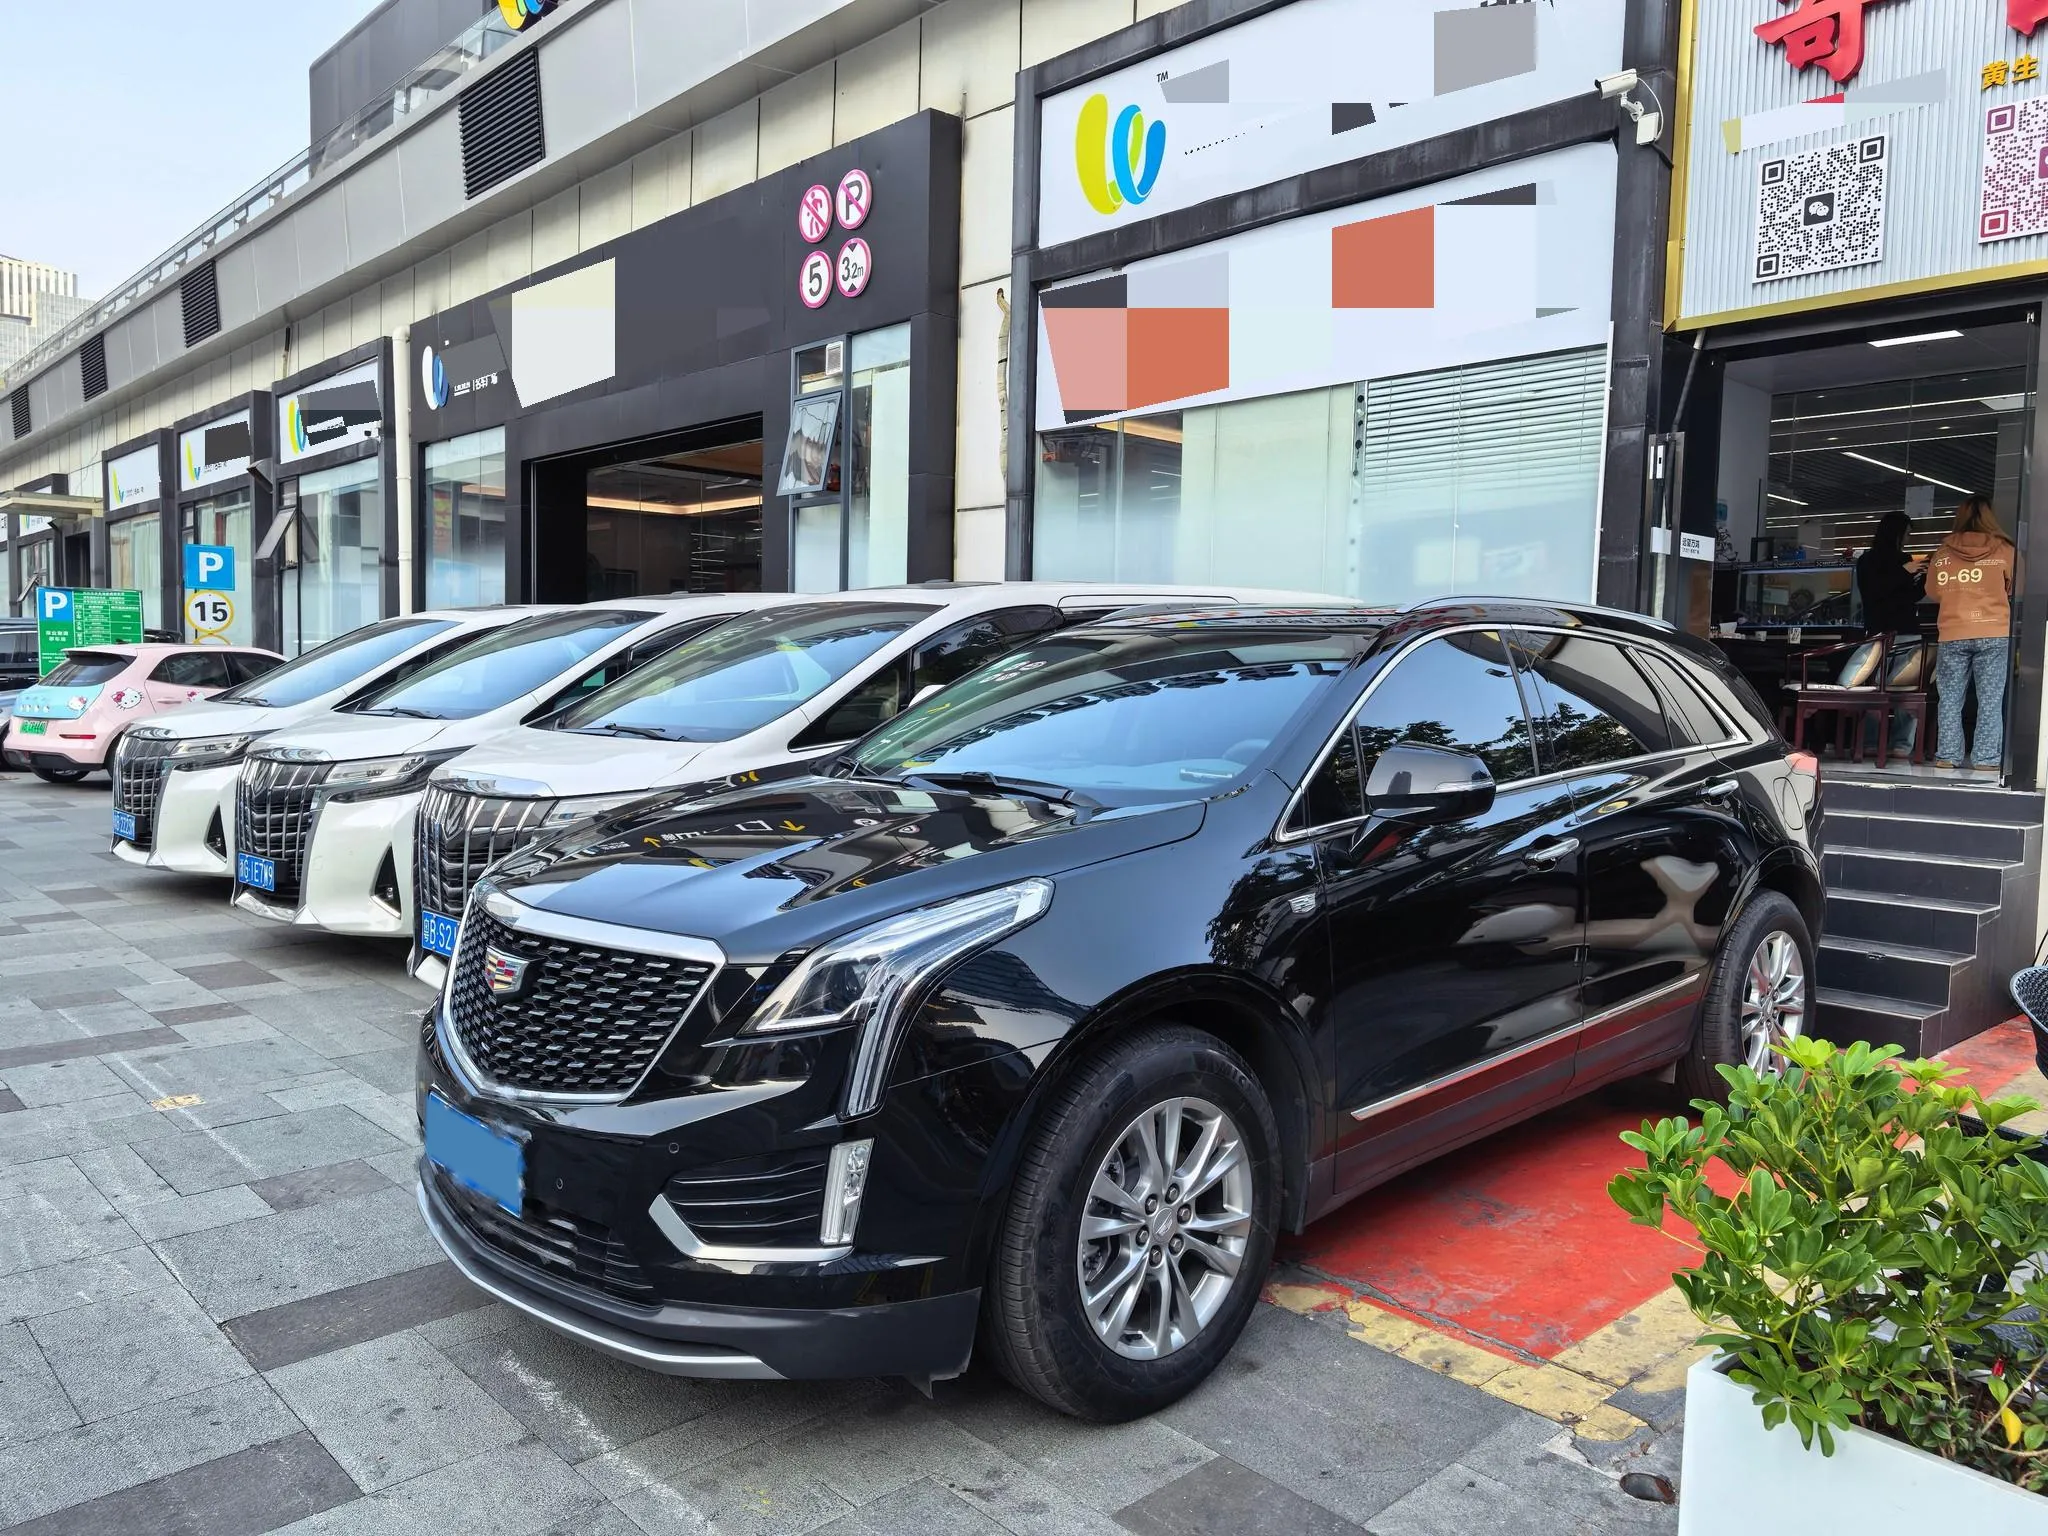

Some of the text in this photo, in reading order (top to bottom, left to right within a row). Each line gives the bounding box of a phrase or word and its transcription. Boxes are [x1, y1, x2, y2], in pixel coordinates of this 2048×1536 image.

[1156, 70, 1169, 83] TM
[1981, 53, 2039, 90] 黄生
[845, 179, 863, 221] P
[808, 260, 822, 297] 5
[841, 256, 864, 282] 3.2m
[198, 551, 224, 583] P
[1937, 568, 1983, 586] 9-69
[44, 591, 68, 618] P
[194, 601, 228, 622] 15
[423, 917, 457, 951] 粤B·S2
